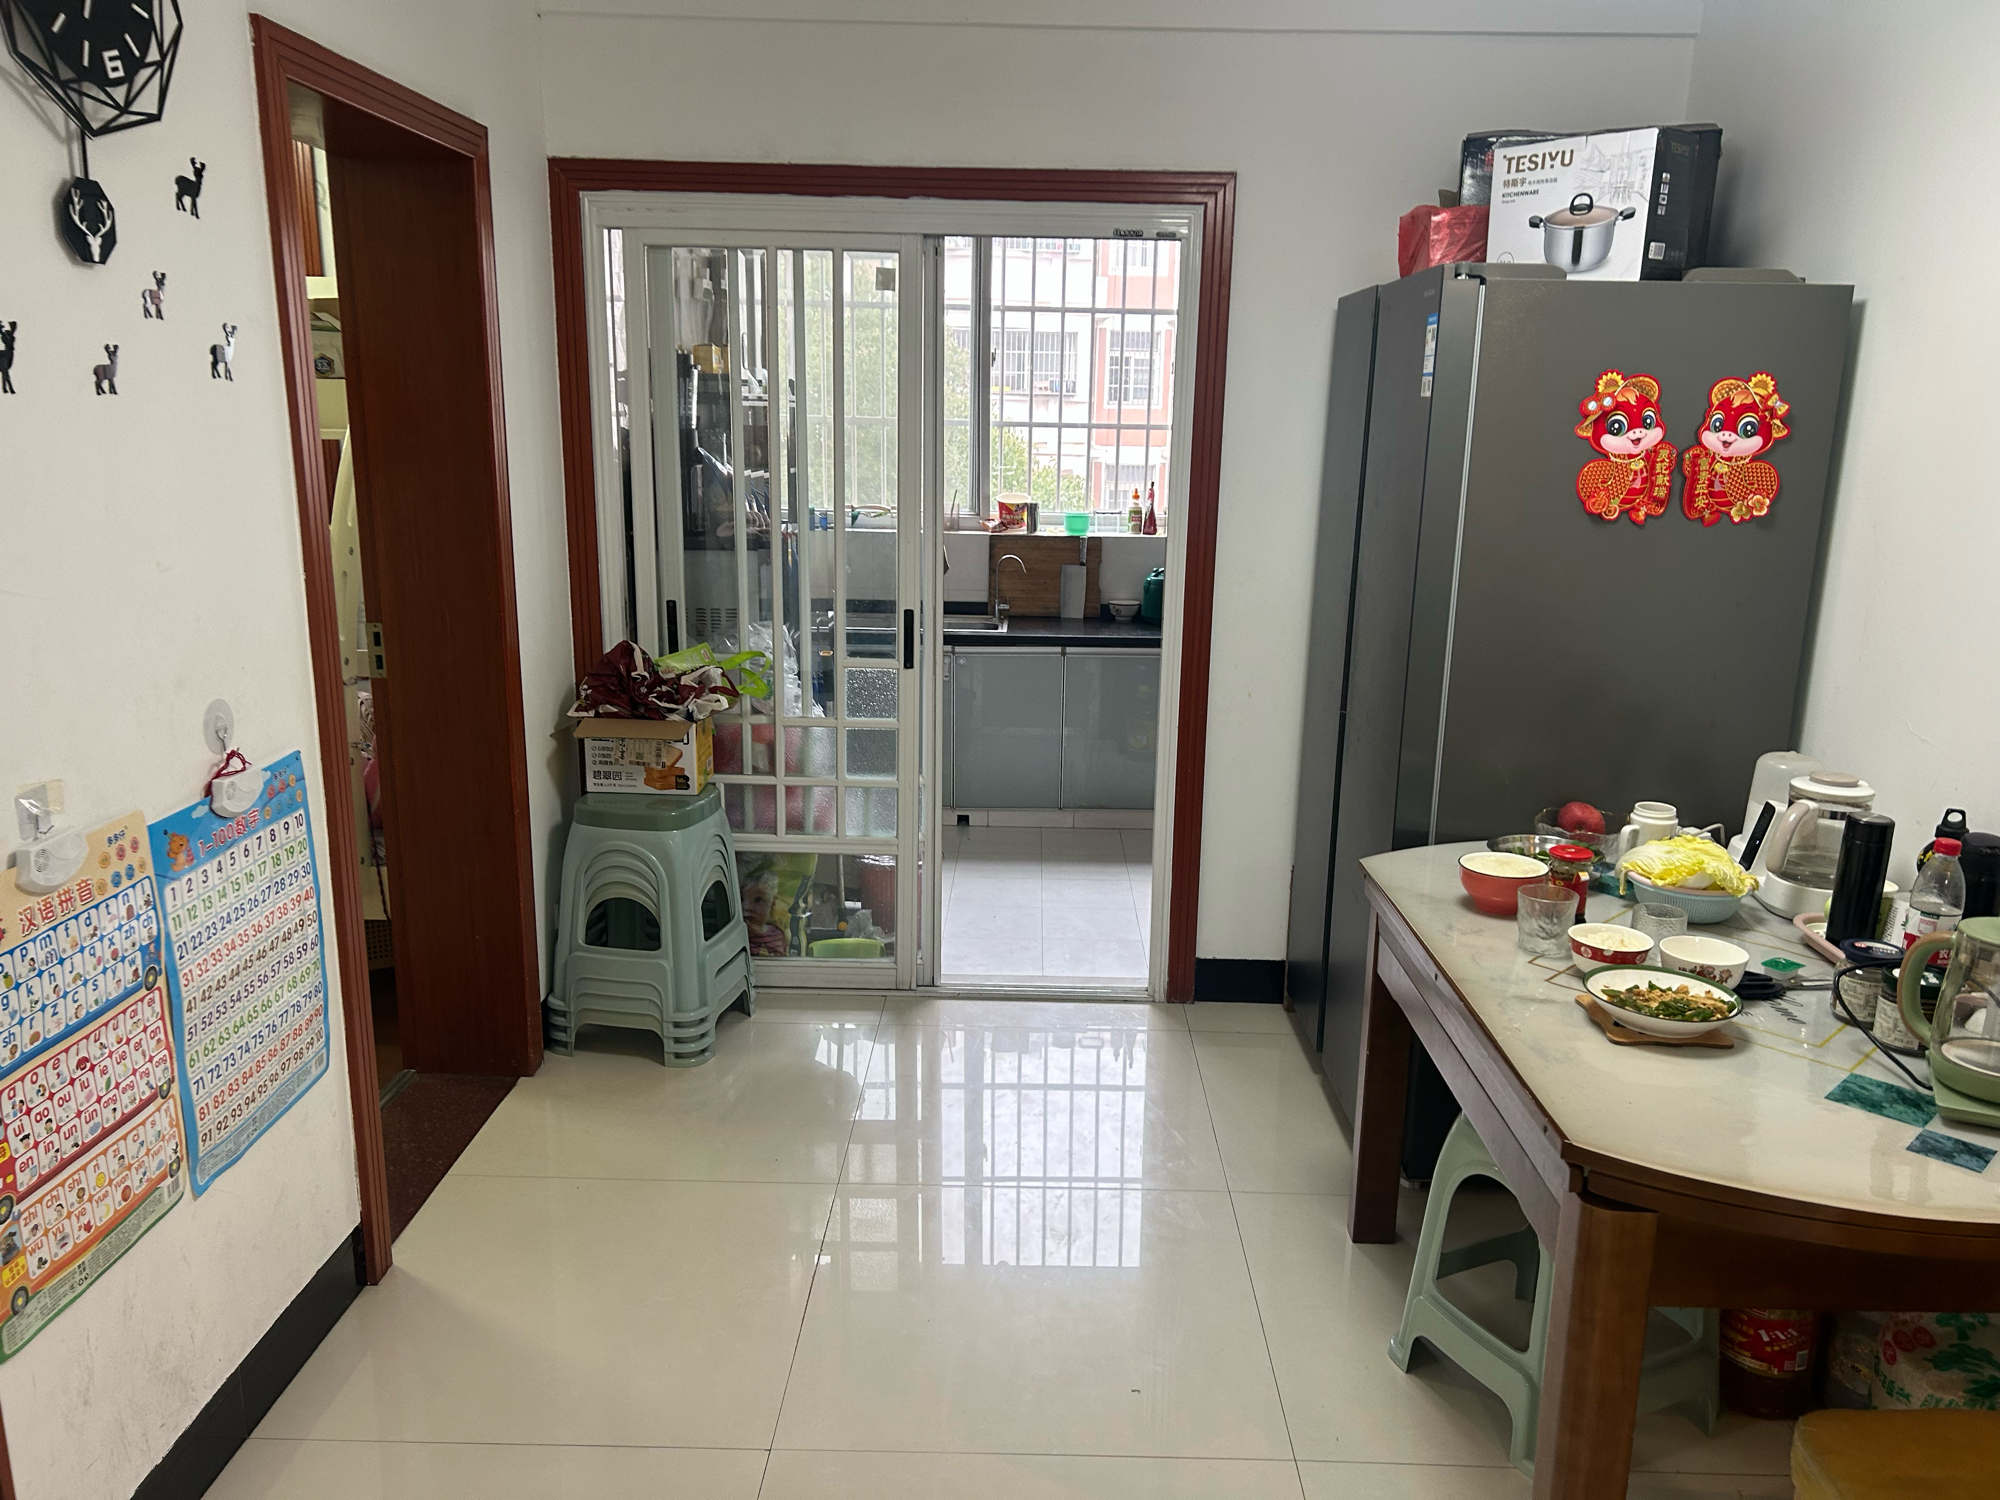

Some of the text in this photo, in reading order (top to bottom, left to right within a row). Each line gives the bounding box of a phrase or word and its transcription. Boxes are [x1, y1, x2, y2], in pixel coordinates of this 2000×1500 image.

[102, 49, 126, 79] 6
[1502, 189, 1539, 198] KITCHENWARE
[1503, 149, 1574, 174] TESIYU
[1653, 449, 1669, 498] 灵蛇献瑞
[1694, 458, 1711, 509] 富贵平安
[171, 814, 303, 901] 1 2 3 4 5 6 7 8 9 10
[172, 838, 306, 931] 11 12 13 14 15 16 17 18 19 20
[19, 878, 93, 935] 汉语拼音
[20, 946, 28, 962] p
[39, 934, 51, 948] m
[64, 924, 70, 938] f
[84, 915, 91, 927] d
[105, 903, 111, 915] t
[122, 894, 128, 904] n
[177, 862, 311, 960] 21 22 23 24 25 26 27 28 29 30
[183, 886, 314, 987] 31 32 33 34 35 36 37 38 39 40
[2, 914, 153, 1011] g k h j q x zh ch
[2, 956, 136, 1047] sh r z c s y w
[186, 927, 292, 1013] 41 42 43 44 45 46 47 48
[187, 960, 281, 1042] 51 52 53 54 55 56 57
[31, 1072, 38, 1084] o
[52, 1058, 60, 1070] e
[93, 1032, 101, 1043] u
[129, 1004, 138, 1018] ai
[147, 993, 156, 1005] ei
[189, 985, 284, 1068] 61 62 63 64 65 66 67
[193, 1009, 288, 1095] 71 72 73 74 75 76 77
[13, 1027, 161, 1137] ui ao ou iu ie üe er an
[19, 1055, 167, 1173] en in un ün ang eng ing ong
[199, 1055, 266, 1121] 81 82 83 84 85
[201, 1129, 212, 1147] 91
[216, 1115, 229, 1135] 92
[231, 1103, 242, 1122] 93
[245, 1091, 256, 1110] 94
[258, 1079, 267, 1098] 95
[23, 1208, 38, 1227] zhi
[46, 1189, 60, 1209] chi
[67, 1172, 82, 1192] shi
[93, 1158, 99, 1173] ri
[112, 1143, 120, 1158] zi
[28, 1241, 43, 1257] wu
[51, 1224, 64, 1240] yu
[74, 1208, 87, 1223] ye
[95, 1190, 109, 1207] yue
